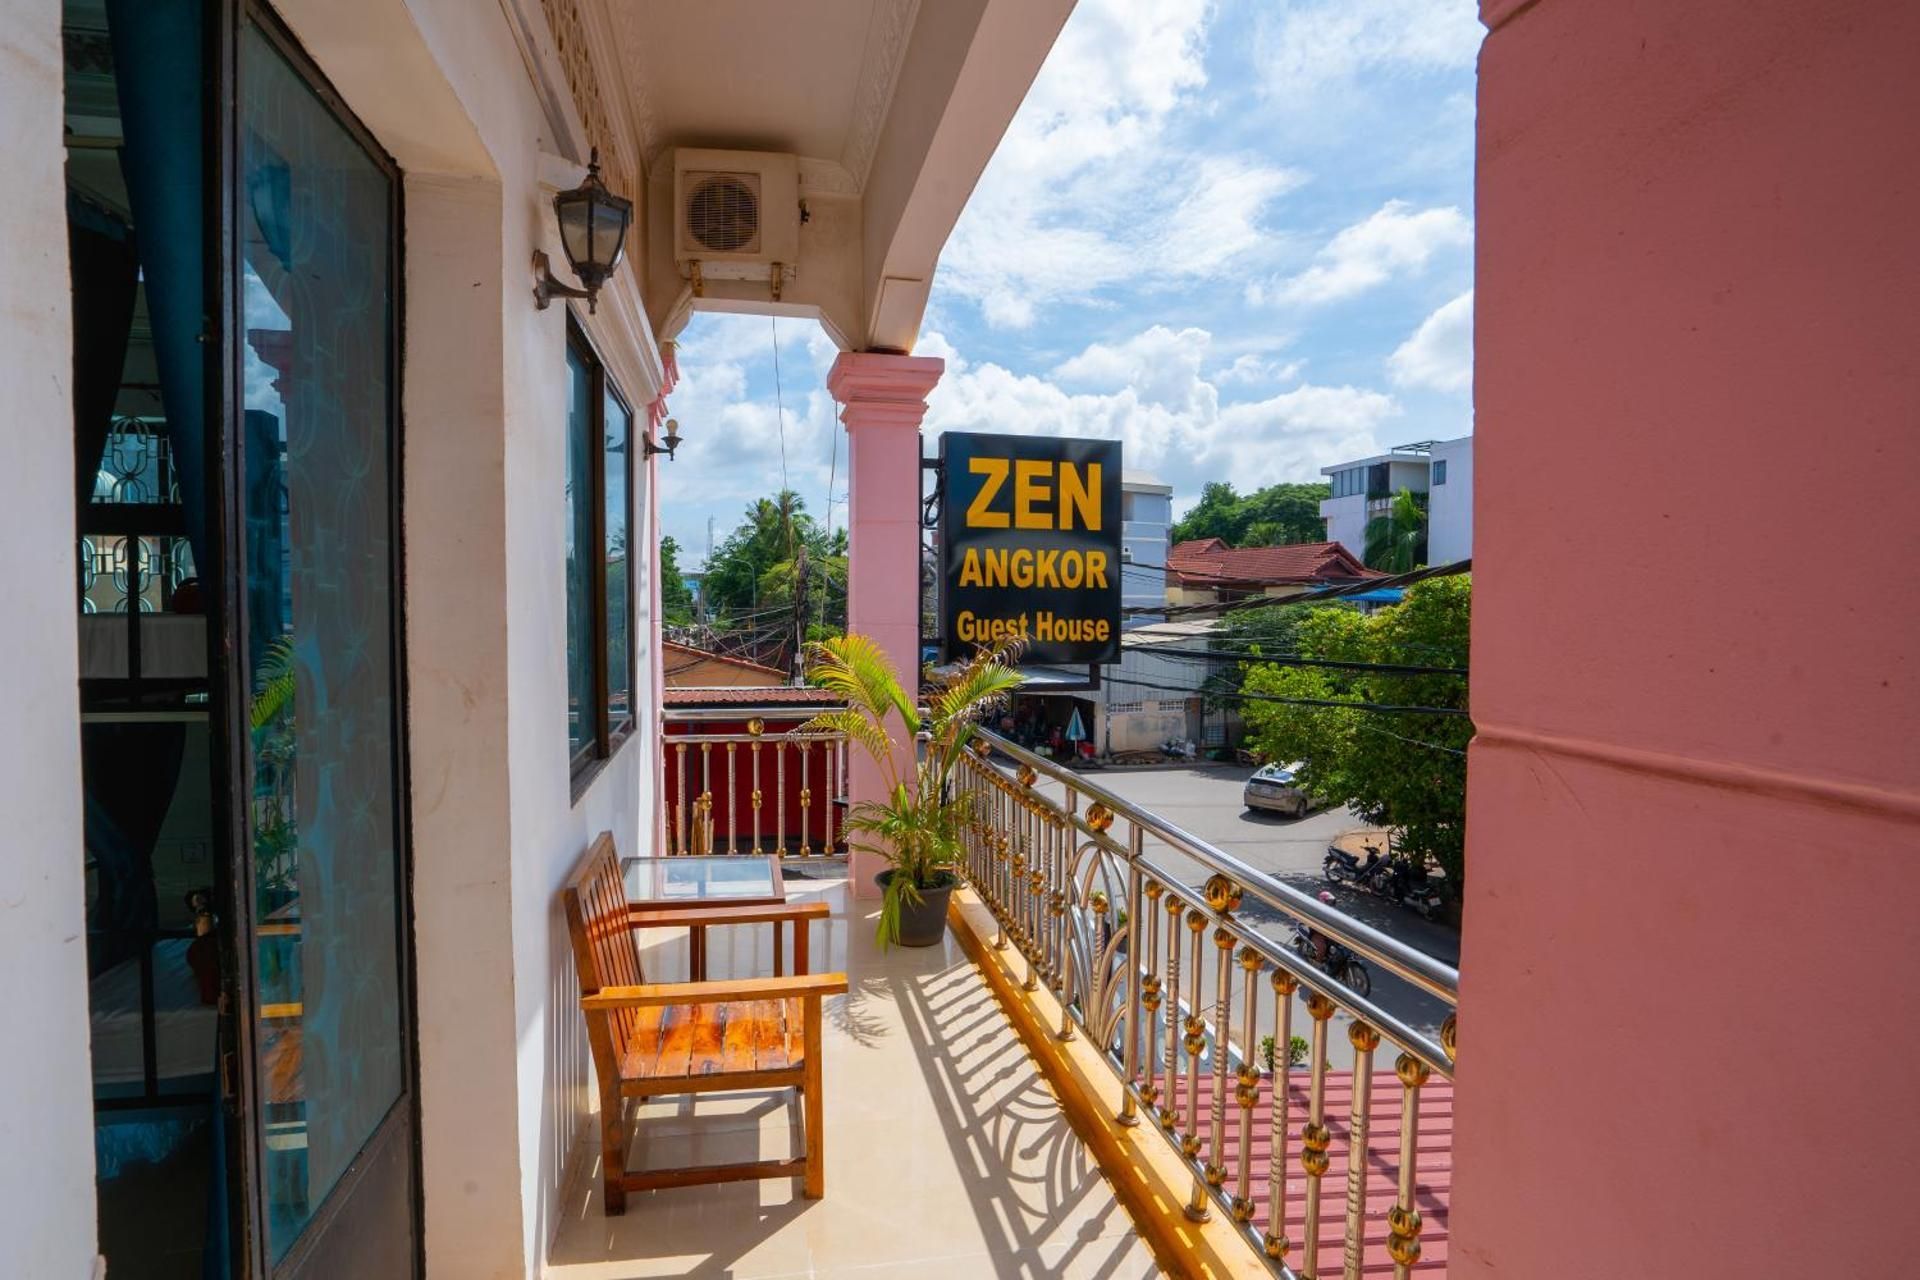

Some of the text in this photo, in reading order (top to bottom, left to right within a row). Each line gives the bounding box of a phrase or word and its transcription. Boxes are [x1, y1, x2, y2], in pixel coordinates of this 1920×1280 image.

[966, 457, 1102, 531] ZEN
[959, 548, 1108, 589] ANGKOR
[957, 610, 1110, 642] Guest House
